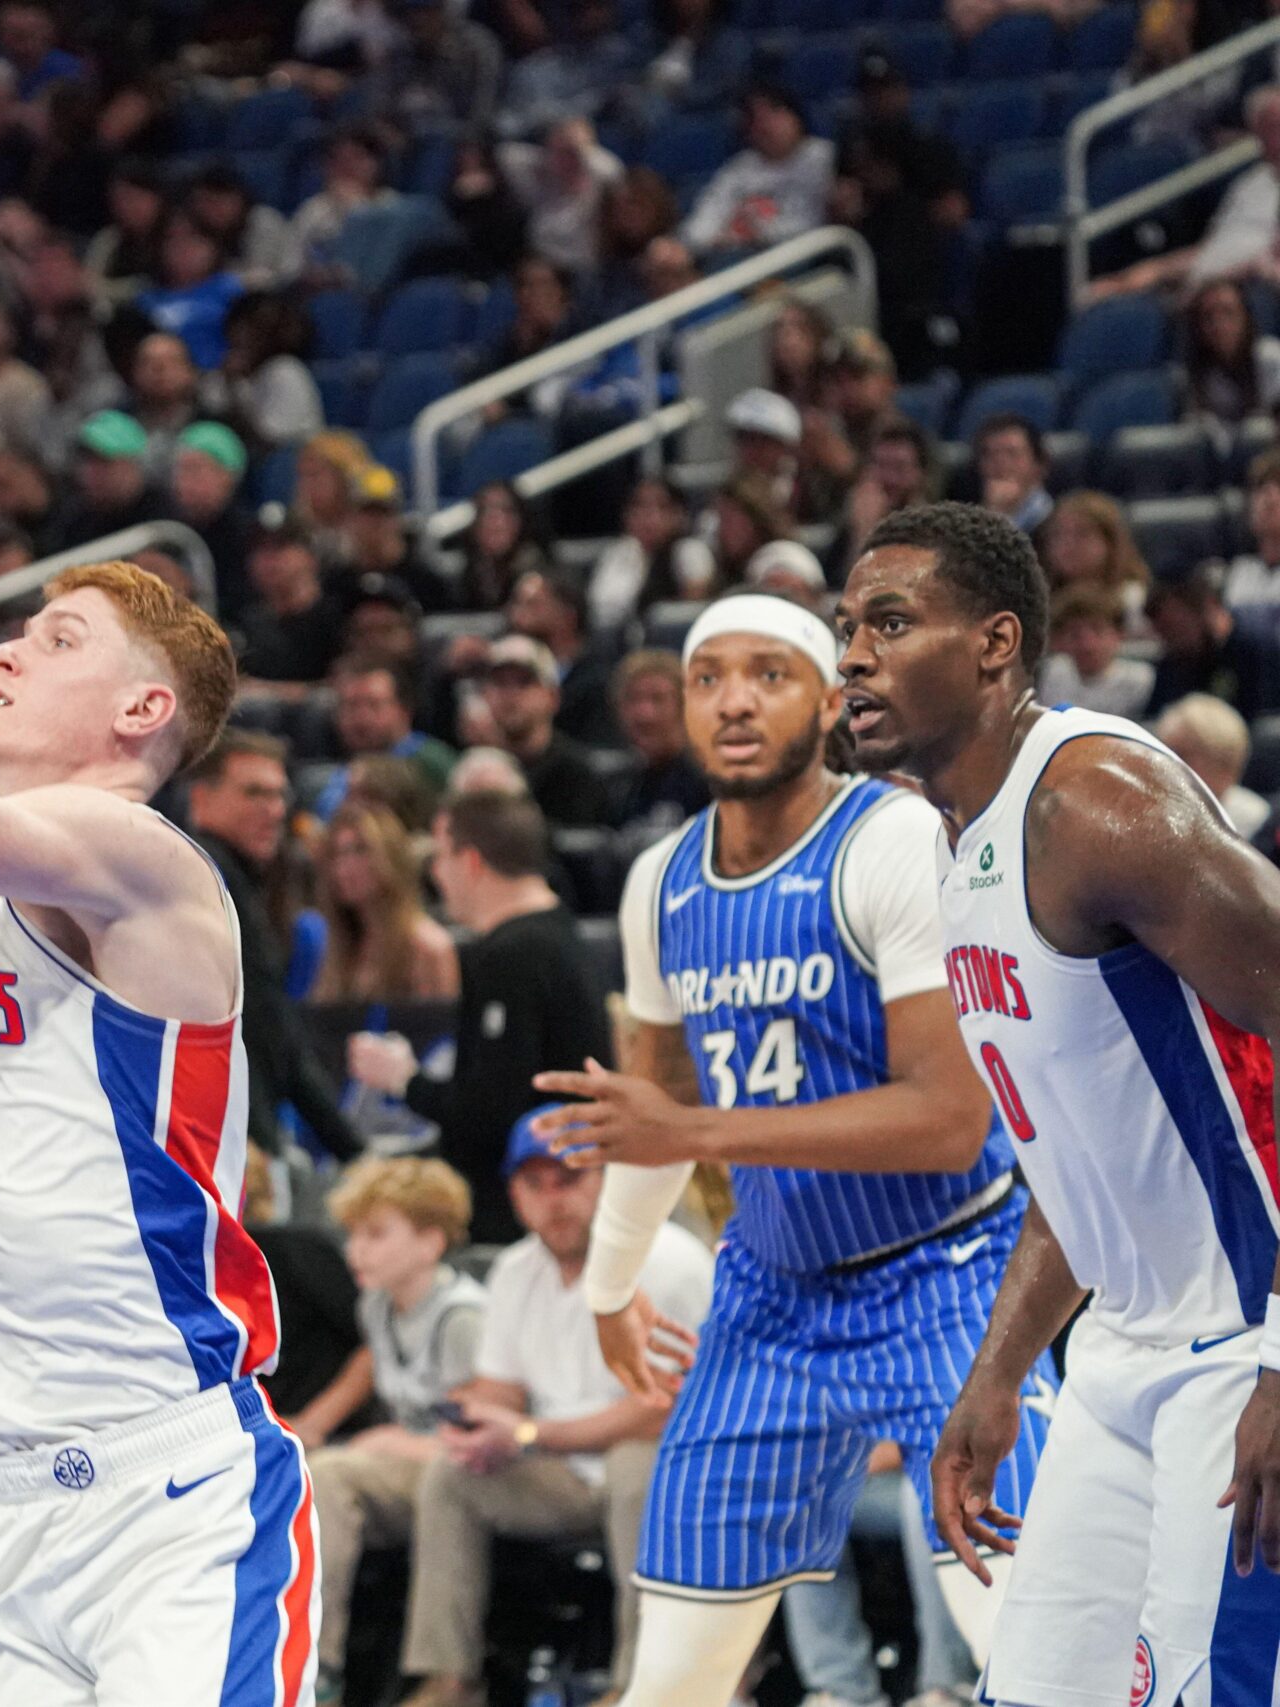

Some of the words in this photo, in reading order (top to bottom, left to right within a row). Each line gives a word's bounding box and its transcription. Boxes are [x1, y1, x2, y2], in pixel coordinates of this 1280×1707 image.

[969, 871, 1005, 891] StockX
[703, 1017, 804, 1110] 34
[980, 1042, 1036, 1142] 0
